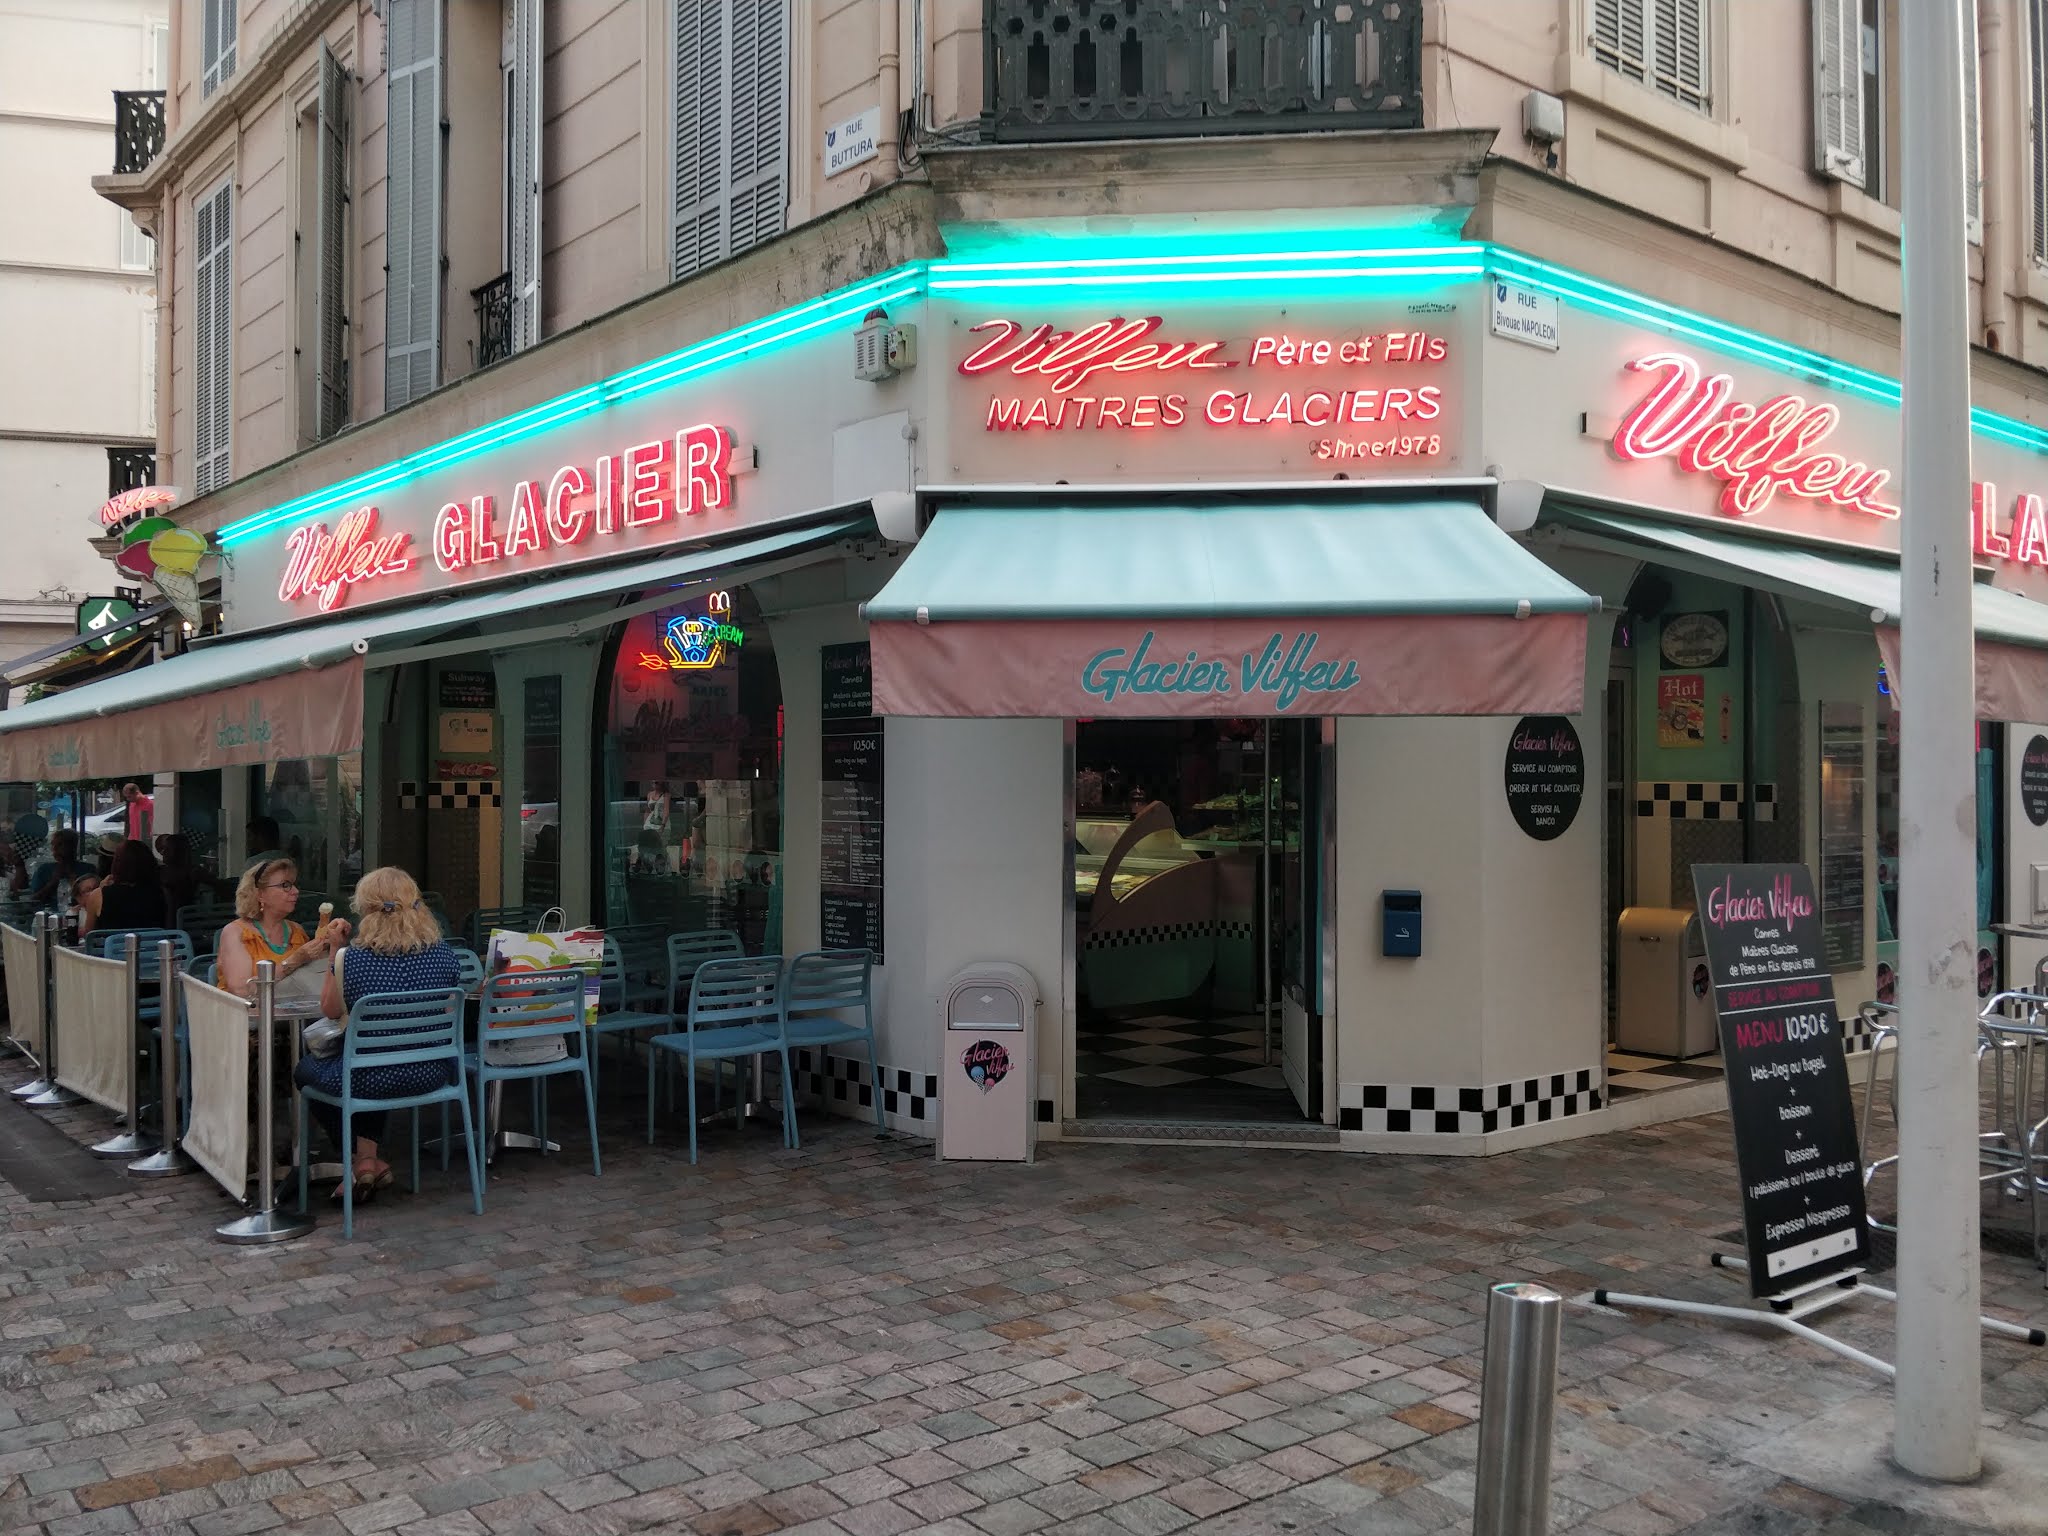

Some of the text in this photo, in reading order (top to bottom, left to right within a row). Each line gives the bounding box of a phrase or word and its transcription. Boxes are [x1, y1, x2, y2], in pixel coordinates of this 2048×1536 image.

[845, 119, 863, 136] RUE
[831, 137, 873, 168] BUTTURA
[1517, 292, 1537, 309] RUE
[1496, 311, 1556, 340] Bivouac NAPOLEON
[1249, 333, 1331, 367] Père
[1339, 335, 1374, 366] et
[986, 386, 1441, 431] MAITRES GLACIERS
[433, 423, 732, 572] GLACIER
[1081, 631, 1231, 703] Glacier
[1664, 679, 1698, 697] Hot
[1514, 728, 1547, 752] Glacier
[1512, 764, 1577, 773] SERVICE AU COMPTOIR
[1509, 784, 1580, 793] ORDER AT THE COUNTER
[1553, 805, 1560, 814] AL
[1536, 817, 1555, 826] BANCO
[1708, 873, 1767, 929] Glacier
[1754, 927, 1779, 939] Cannes
[1770, 943, 1799, 955] Glaciers
[1729, 965, 1739, 977] de
[1739, 962, 1756, 976] Père
[1757, 964, 1767, 974] en
[1781, 958, 1802, 973] depuis
[1728, 988, 1761, 1008] SERVICE
[1736, 1017, 1784, 1049] MENU
[960, 1039, 1009, 1066] Glacier
[1750, 1055, 1826, 1081] Hot-Dog ou Bagel
[1784, 1143, 1820, 1165] Dessert
[1790, 1175, 1801, 1186] ou
[1765, 1204, 1850, 1241] Expresso Nespresso
